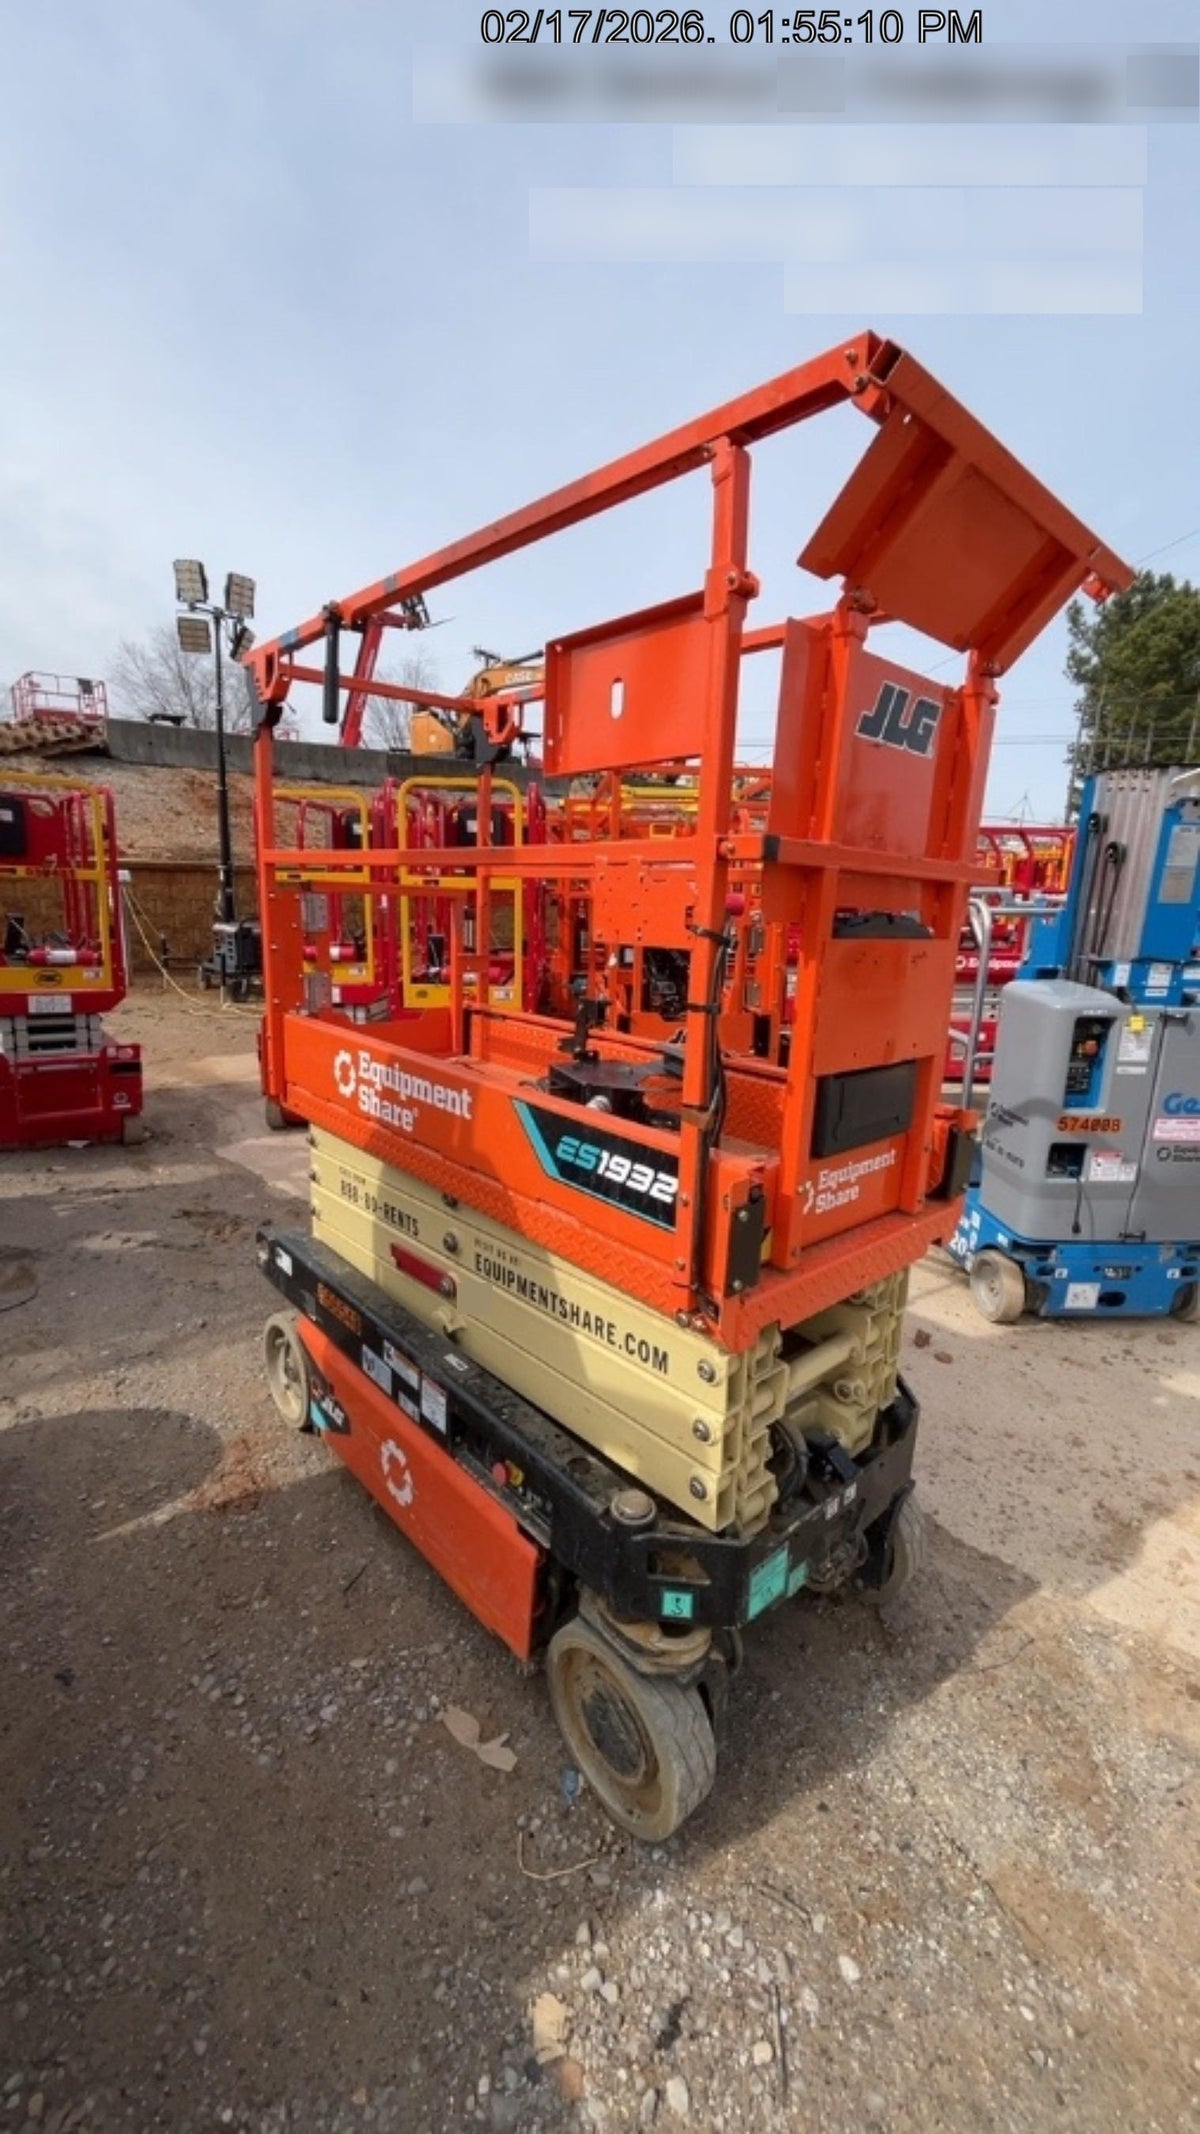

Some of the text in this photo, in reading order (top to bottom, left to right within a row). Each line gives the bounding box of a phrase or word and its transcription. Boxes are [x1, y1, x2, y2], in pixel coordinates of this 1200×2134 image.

[855, 681, 943, 759] JLG
[358, 1050, 472, 1120] Equipment
[358, 1084, 414, 1132] Share
[556, 1135, 679, 1204] ES1932
[815, 1184, 860, 1215] Share
[818, 1149, 896, 1192] Equipment
[475, 1252, 669, 1375] EQUIPMENTSHARE.COM
